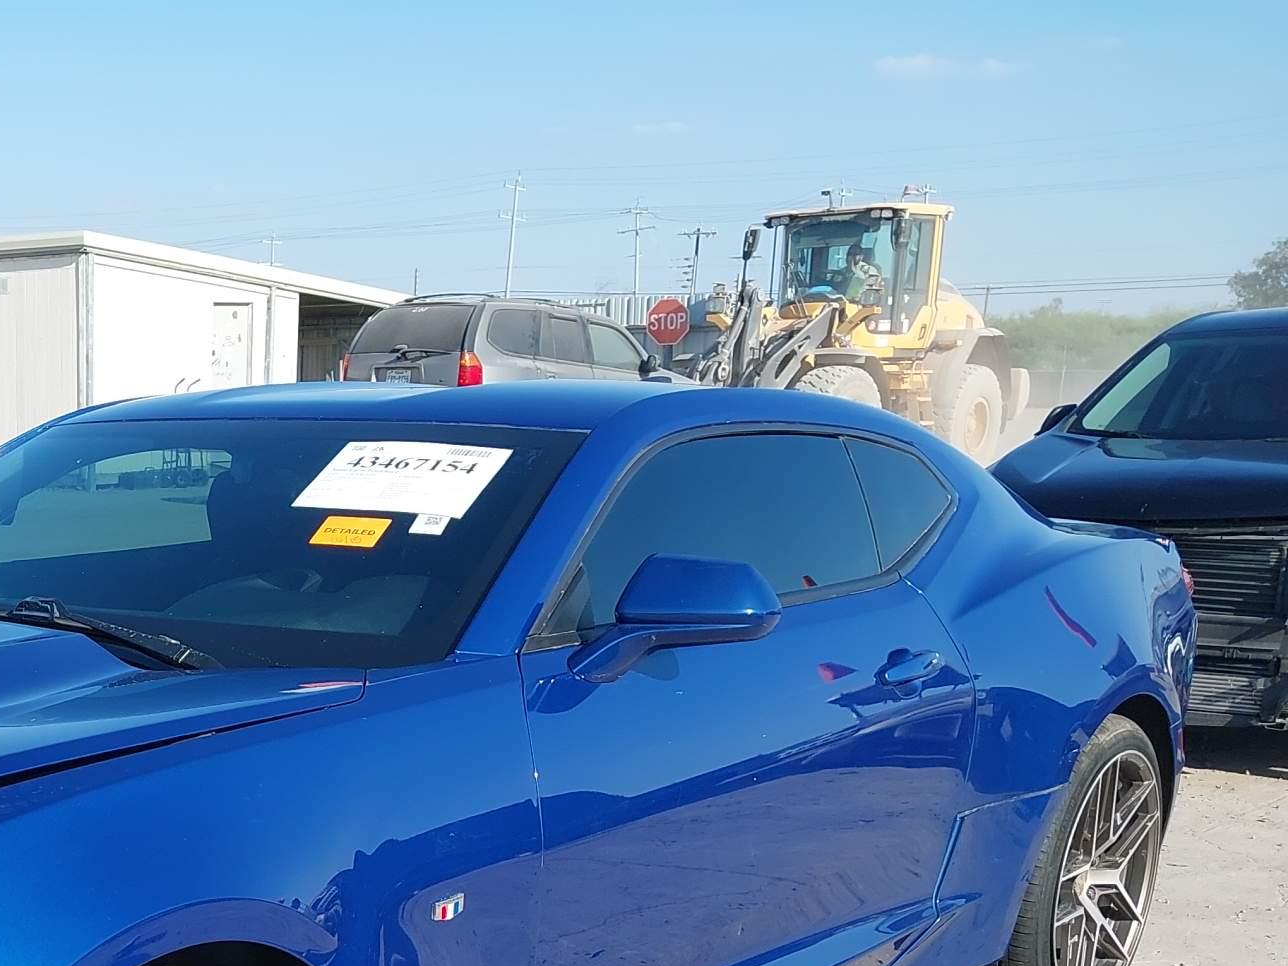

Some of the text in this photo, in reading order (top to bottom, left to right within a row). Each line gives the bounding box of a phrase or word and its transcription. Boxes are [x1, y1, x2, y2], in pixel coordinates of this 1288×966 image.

[649, 312, 686, 331] STOP
[347, 455, 479, 475] 43467154
[323, 527, 376, 536] DETAILED
